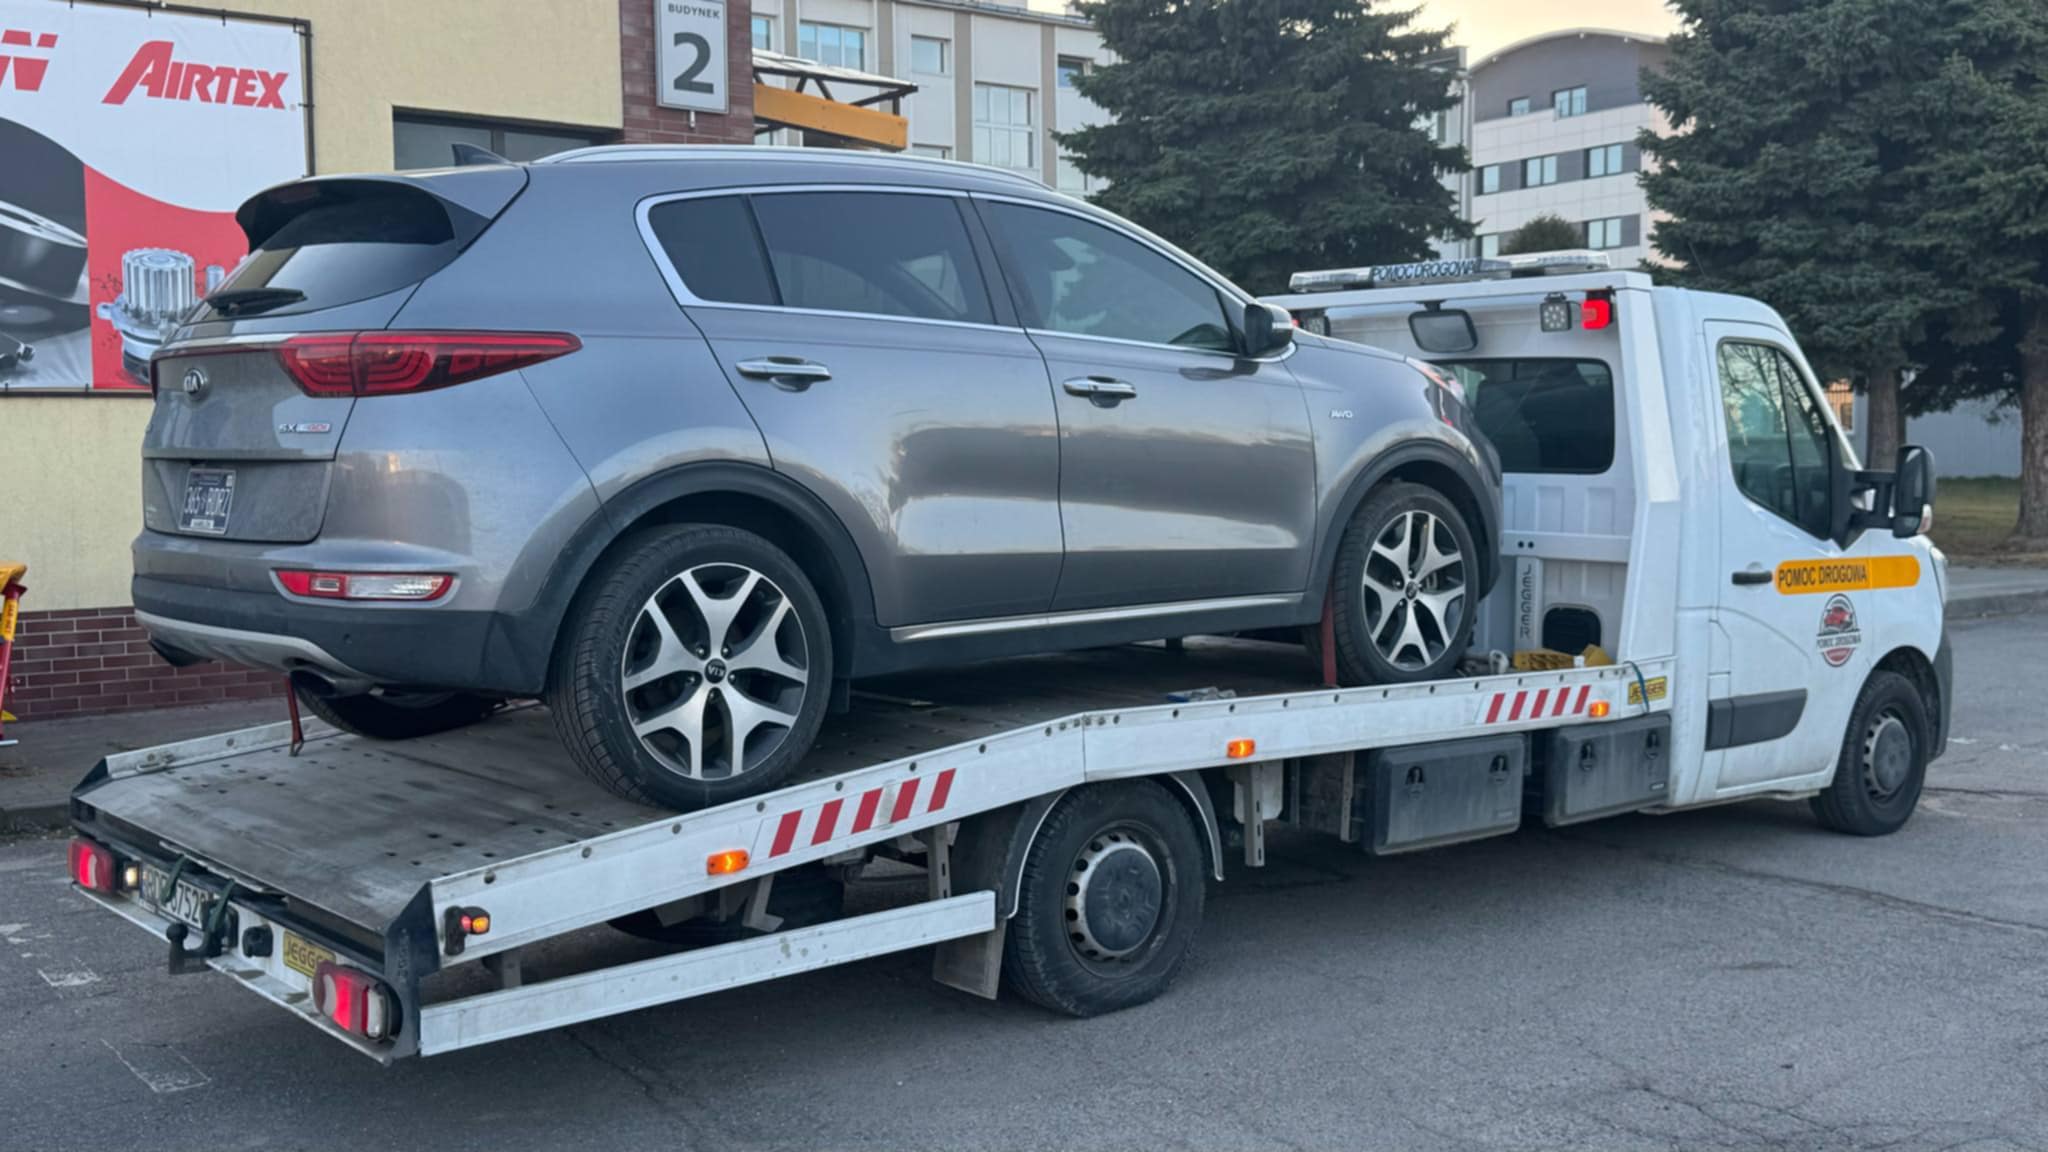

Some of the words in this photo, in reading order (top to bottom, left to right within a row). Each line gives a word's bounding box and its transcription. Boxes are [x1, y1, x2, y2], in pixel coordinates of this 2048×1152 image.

[667, 3, 720, 19] BUDYNEK
[101, 40, 289, 110] AIRTEX
[673, 31, 714, 94] 2
[1373, 264, 1415, 281] POMOC
[1778, 566, 1817, 588] POMOC
[1818, 564, 1867, 584] DROGOWA
[1520, 563, 1533, 640] JEGGER
[286, 937, 328, 969] JEGG
